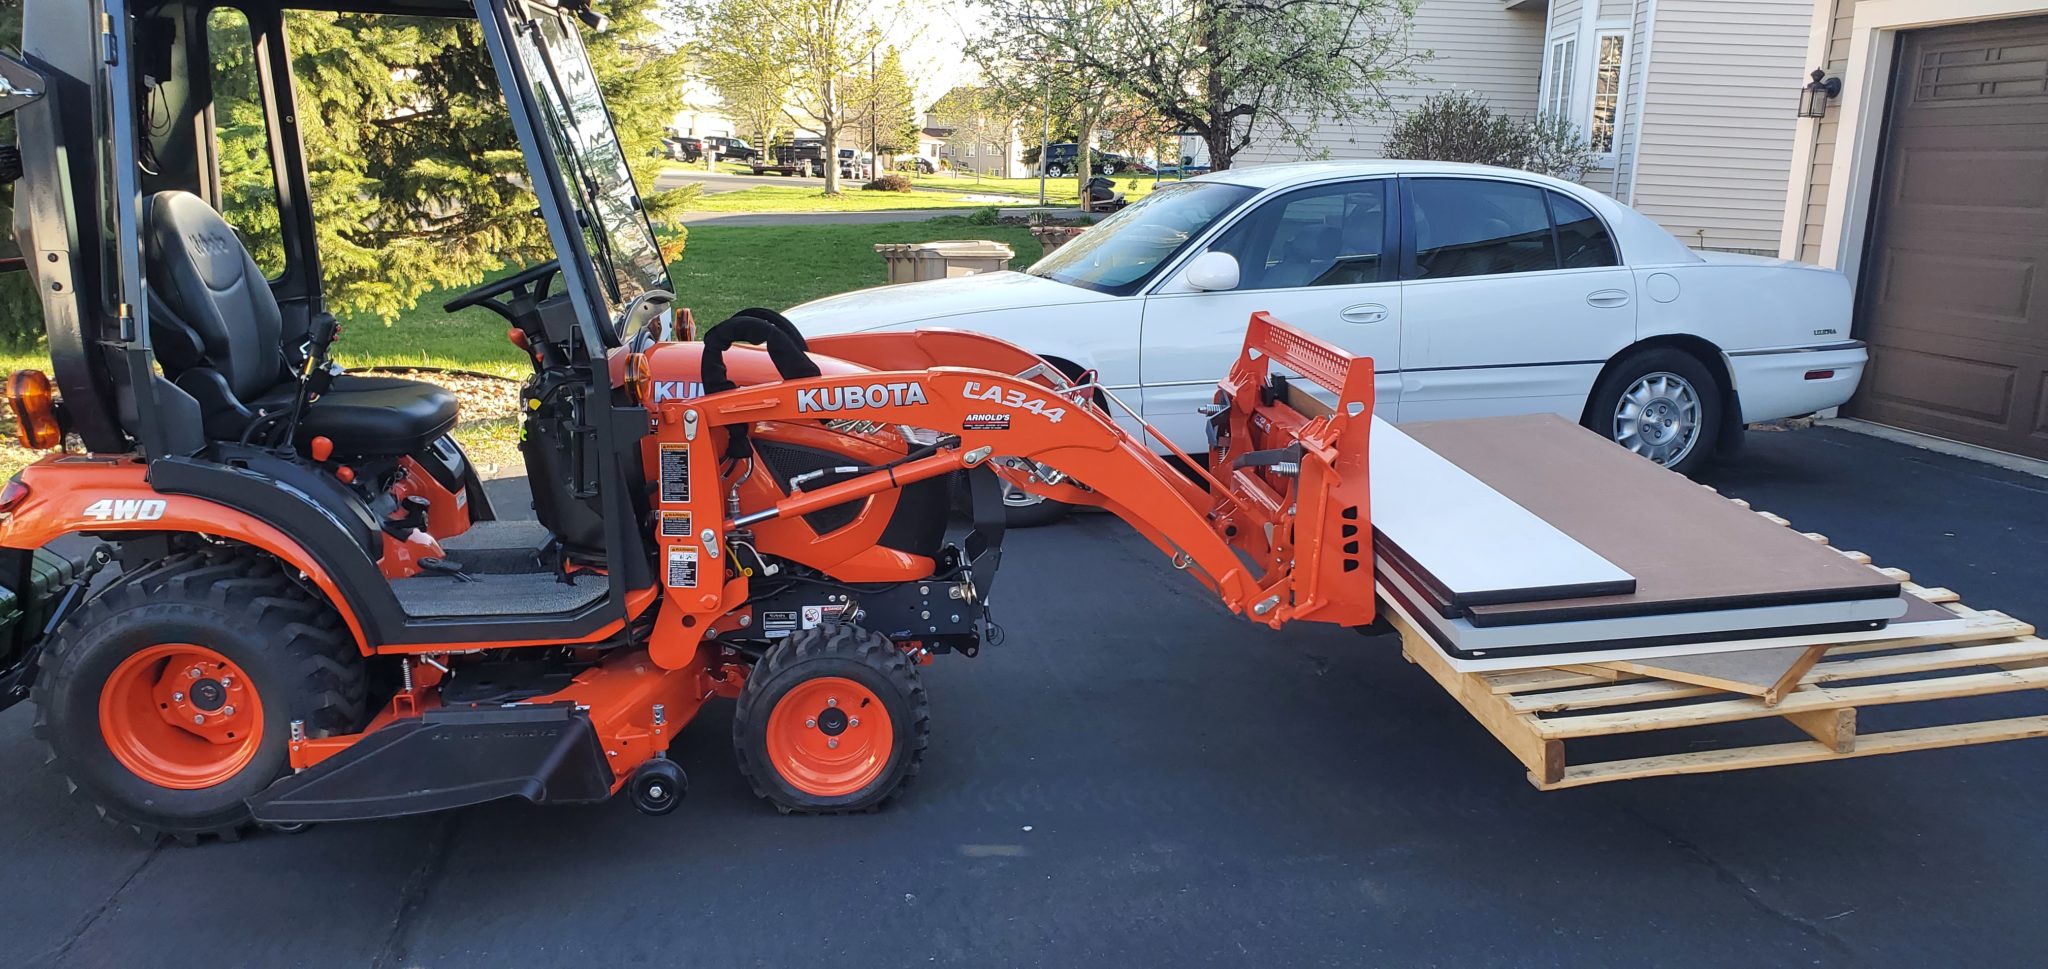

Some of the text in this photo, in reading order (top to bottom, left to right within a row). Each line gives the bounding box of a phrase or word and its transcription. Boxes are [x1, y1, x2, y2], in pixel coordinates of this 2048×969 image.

[797, 382, 928, 413] KUBOTA
[962, 381, 1066, 423] LA344
[83, 499, 168, 521] 4WD
